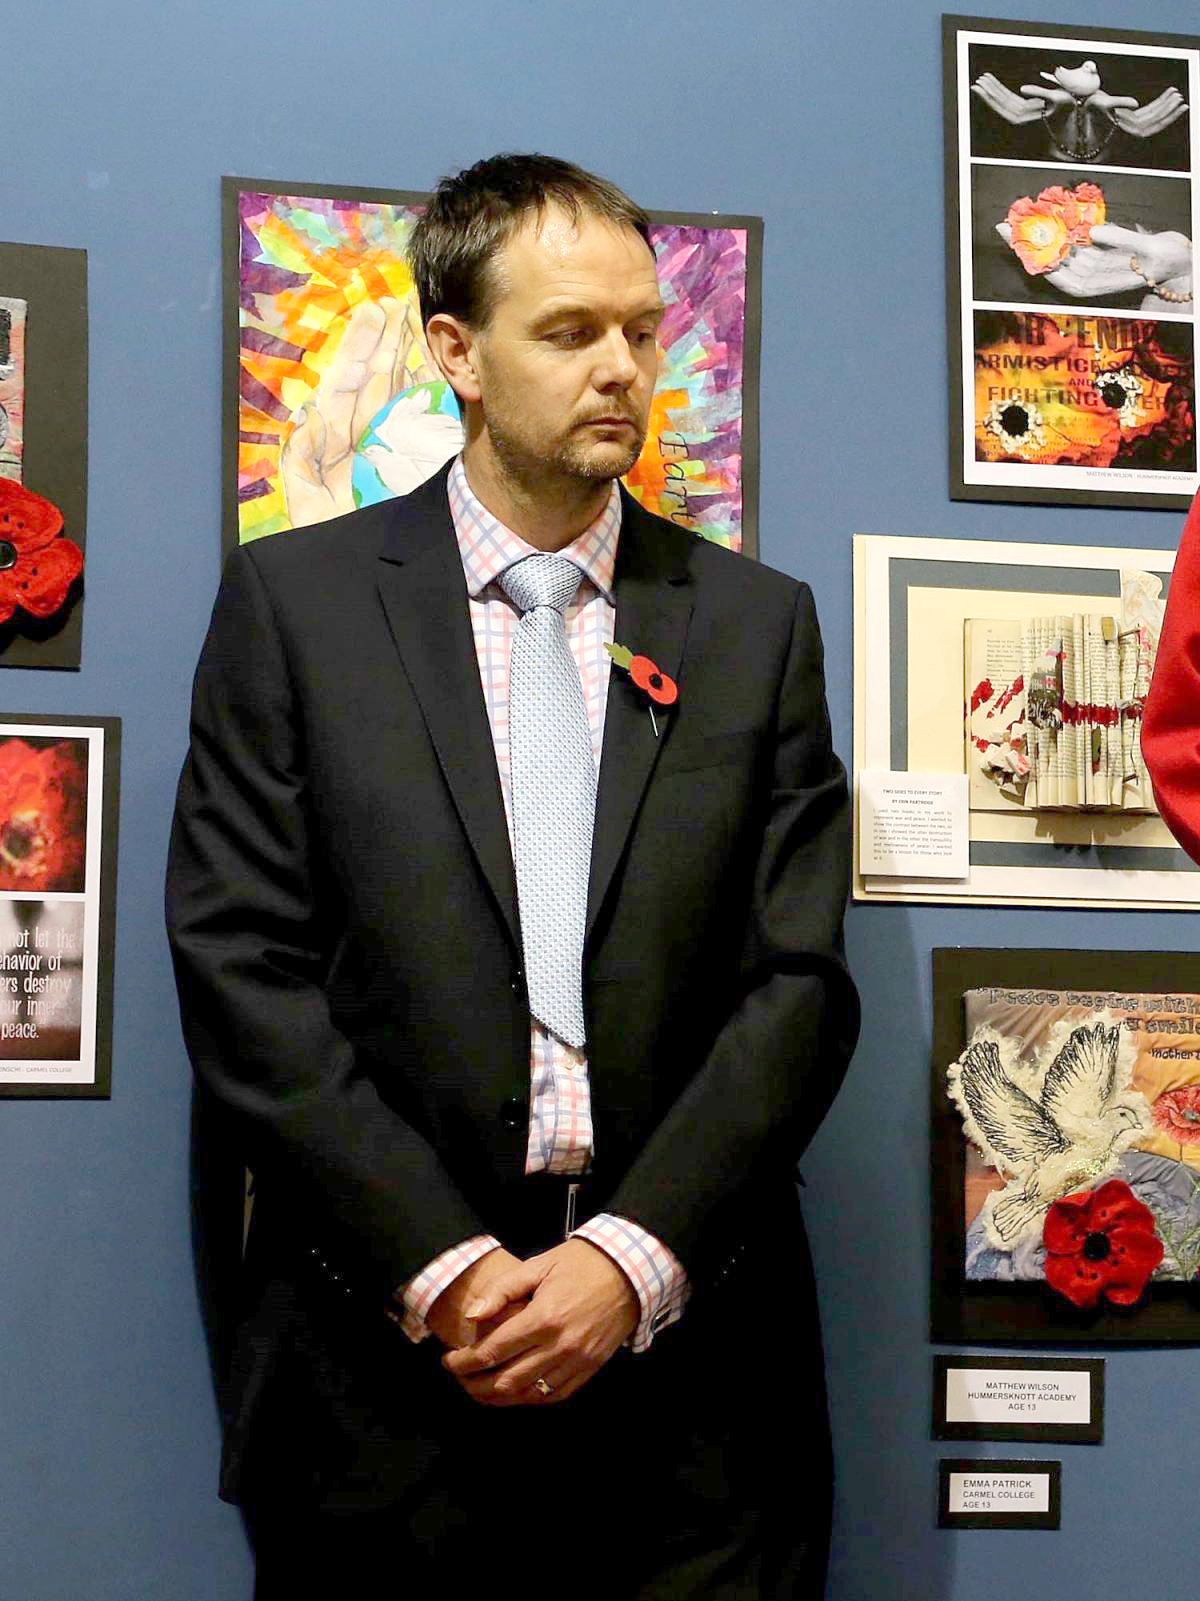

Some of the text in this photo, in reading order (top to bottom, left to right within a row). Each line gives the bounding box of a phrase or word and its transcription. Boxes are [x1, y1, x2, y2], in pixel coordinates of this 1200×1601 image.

[988, 386, 1098, 407] FIGHTING
[658, 433, 700, 532] Eart
[48, 952, 62, 971] of
[24, 971, 72, 997] destroy
[1, 1022, 40, 1040] peace.
[986, 1382, 1059, 1391] MATTHEW WILSON
[968, 1392, 1077, 1401] HUMMERSKNOTT ACADEMY
[1008, 1403, 1025, 1411] AGE
[963, 1480, 1032, 1488] EMMA PATRICK
[963, 1491, 1036, 1499] CARMEL COLLEGE
[963, 1501, 980, 1509] AGE
